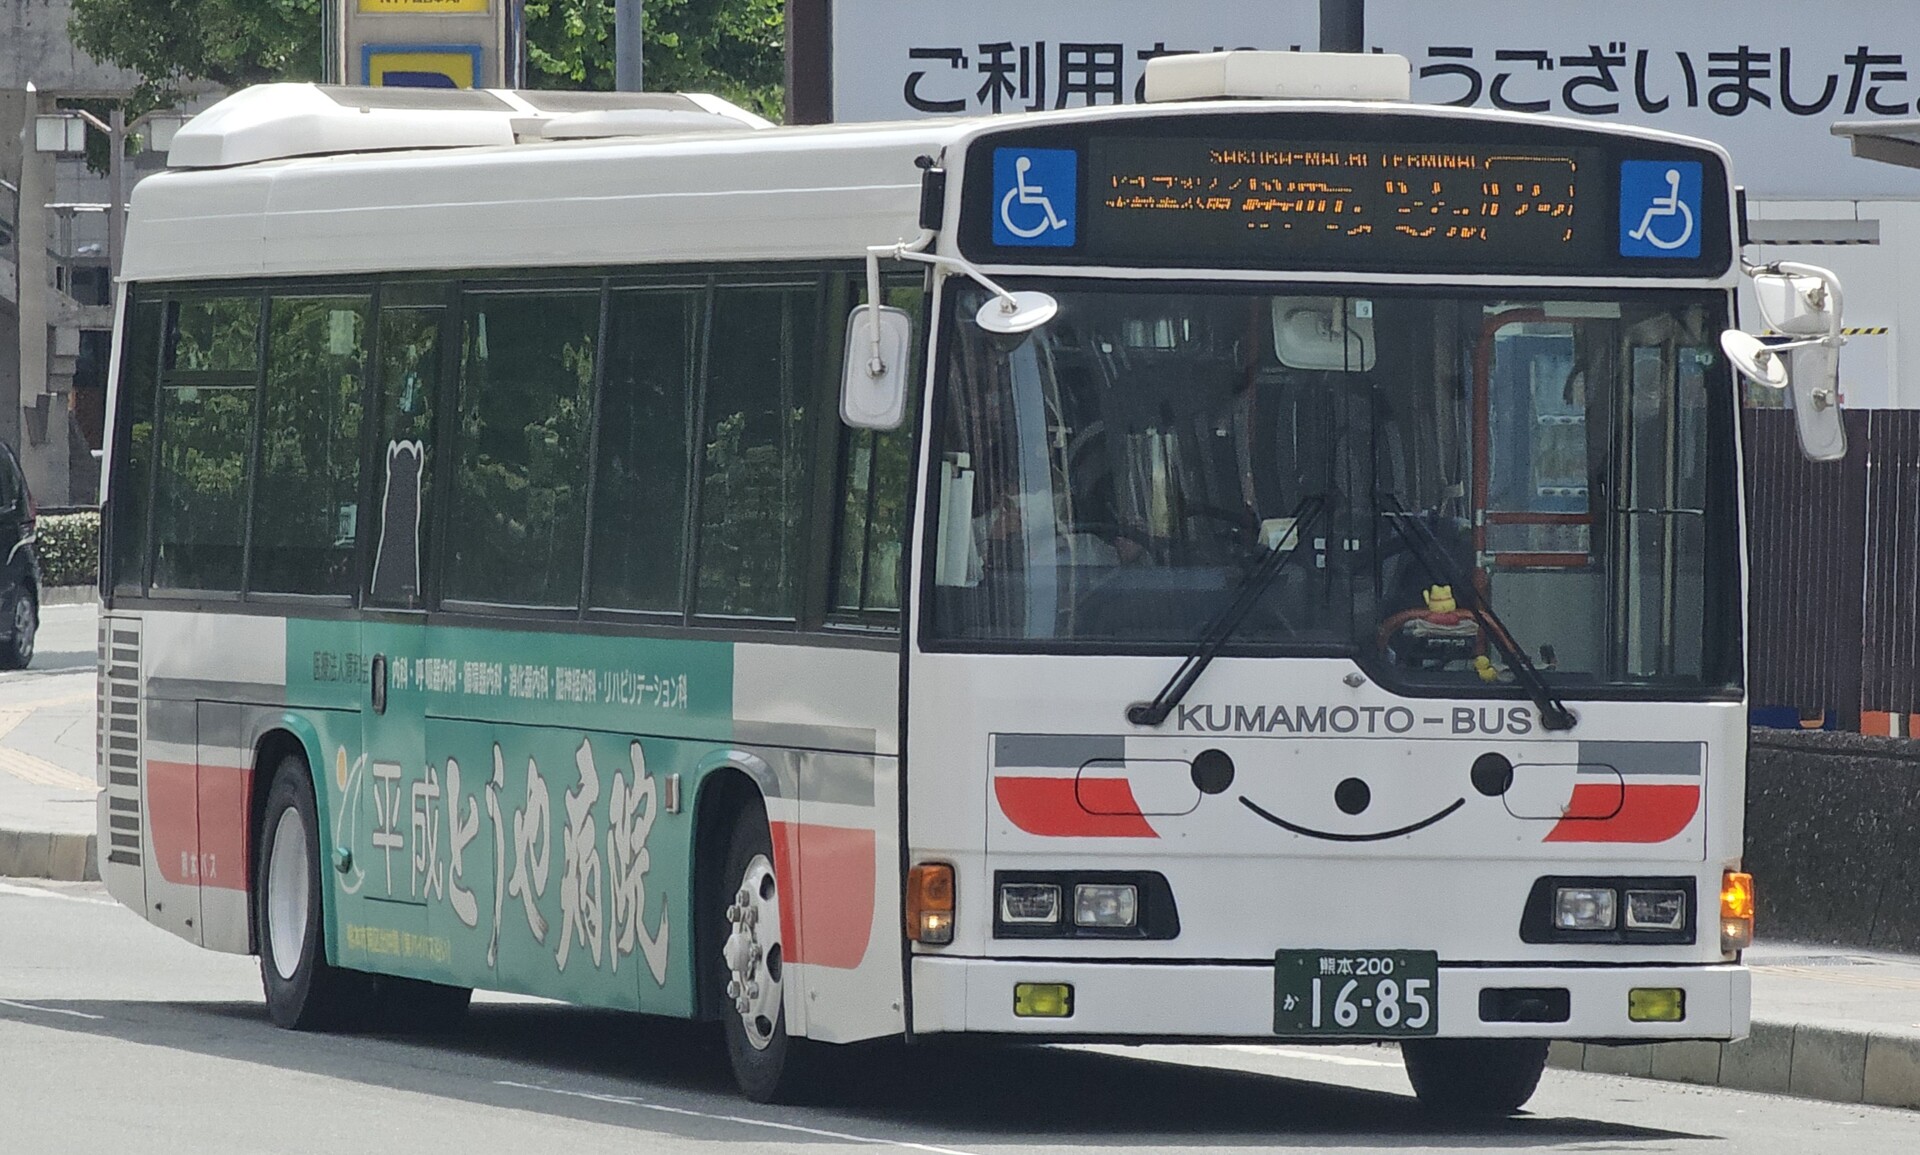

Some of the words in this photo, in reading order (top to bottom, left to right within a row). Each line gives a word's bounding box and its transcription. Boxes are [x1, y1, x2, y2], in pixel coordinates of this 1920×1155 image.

[904, 40, 1920, 116] ご利用うございました
[1283, 993, 1300, 1011] か
[1311, 977, 1431, 1029] 16-85
